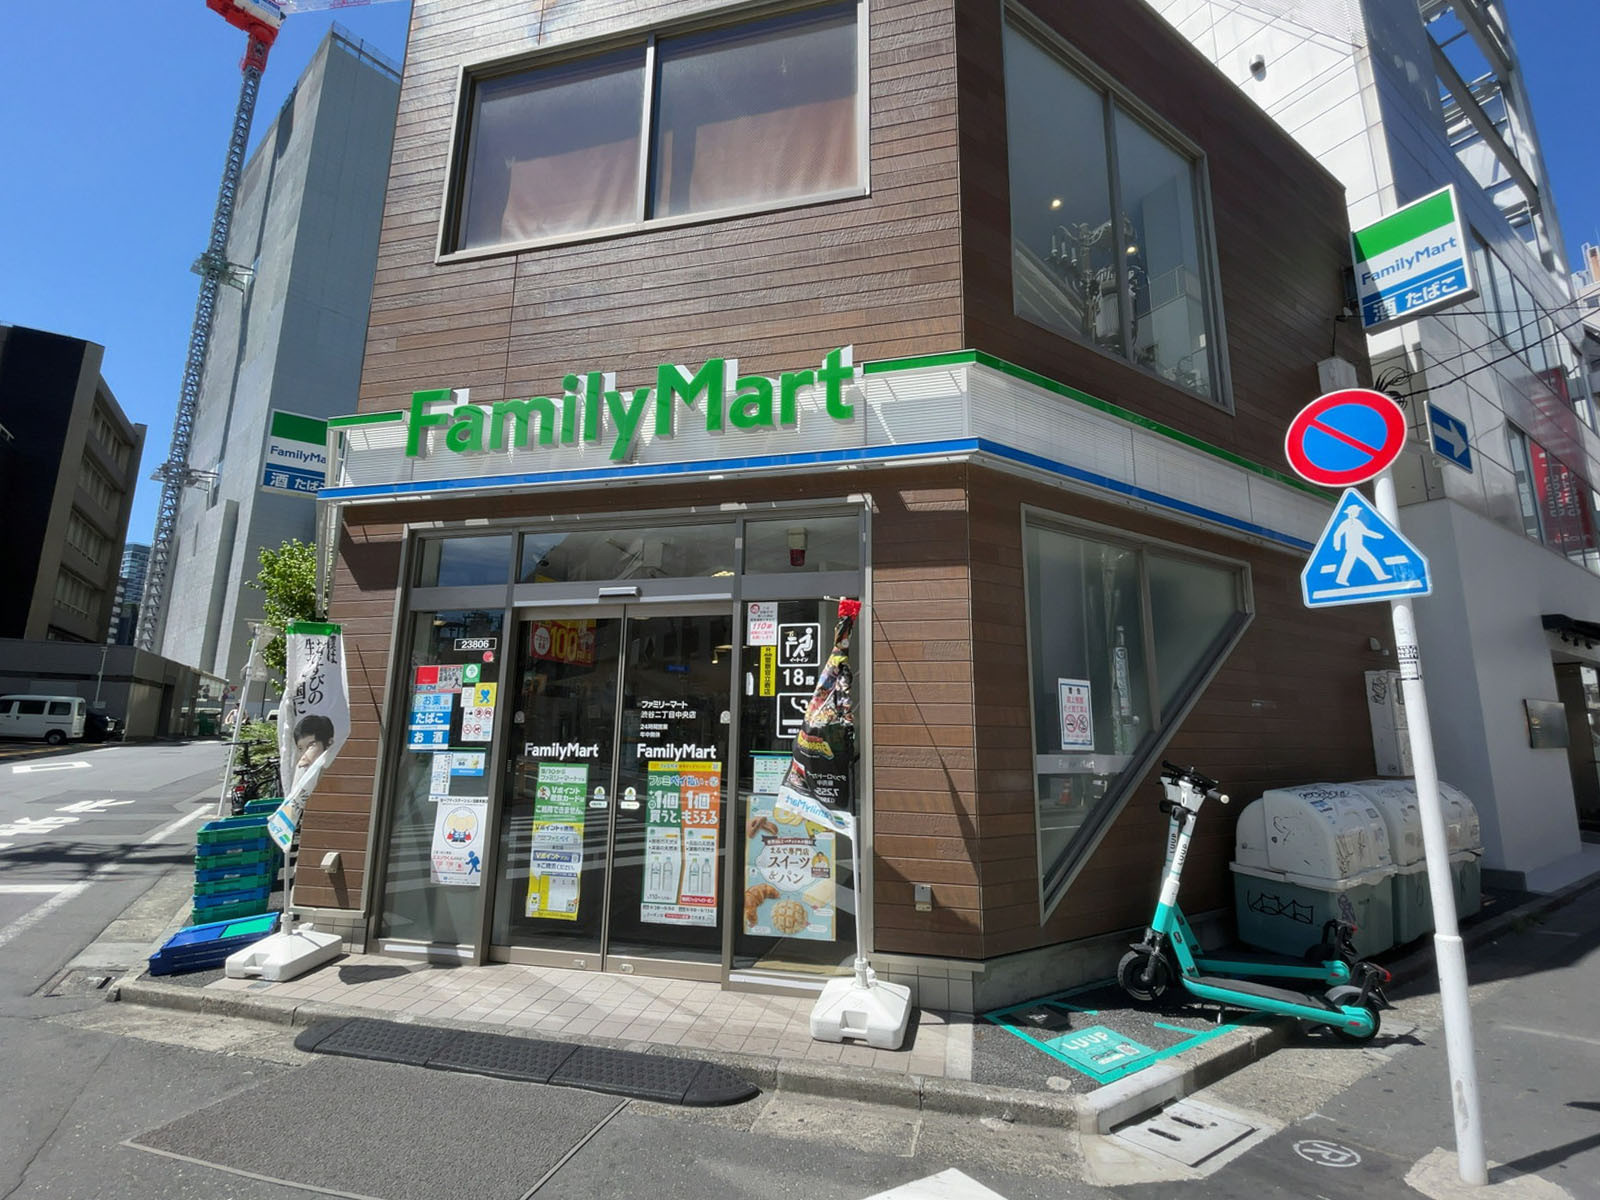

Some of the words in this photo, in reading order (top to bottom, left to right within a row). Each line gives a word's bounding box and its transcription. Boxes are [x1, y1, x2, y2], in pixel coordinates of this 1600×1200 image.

[1361, 236, 1457, 286] FamilyMart
[1404, 275, 1459, 309] たばこ
[405, 346, 856, 461] FamilyMart
[269, 472, 290, 489] 酒
[461, 640, 490, 649] 23806
[641, 700, 689, 709] ファミリーマート
[415, 712, 444, 725] たばこ
[640, 710, 697, 719] 渋谷二丁目中央店
[524, 742, 599, 761] FamilyMart
[636, 743, 717, 761] FamilyMart
[681, 810, 718, 825] もらえる
[769, 847, 810, 857] まるで専門店
[767, 855, 811, 870] スイーツ
[1061, 1031, 1109, 1051] LUUP
